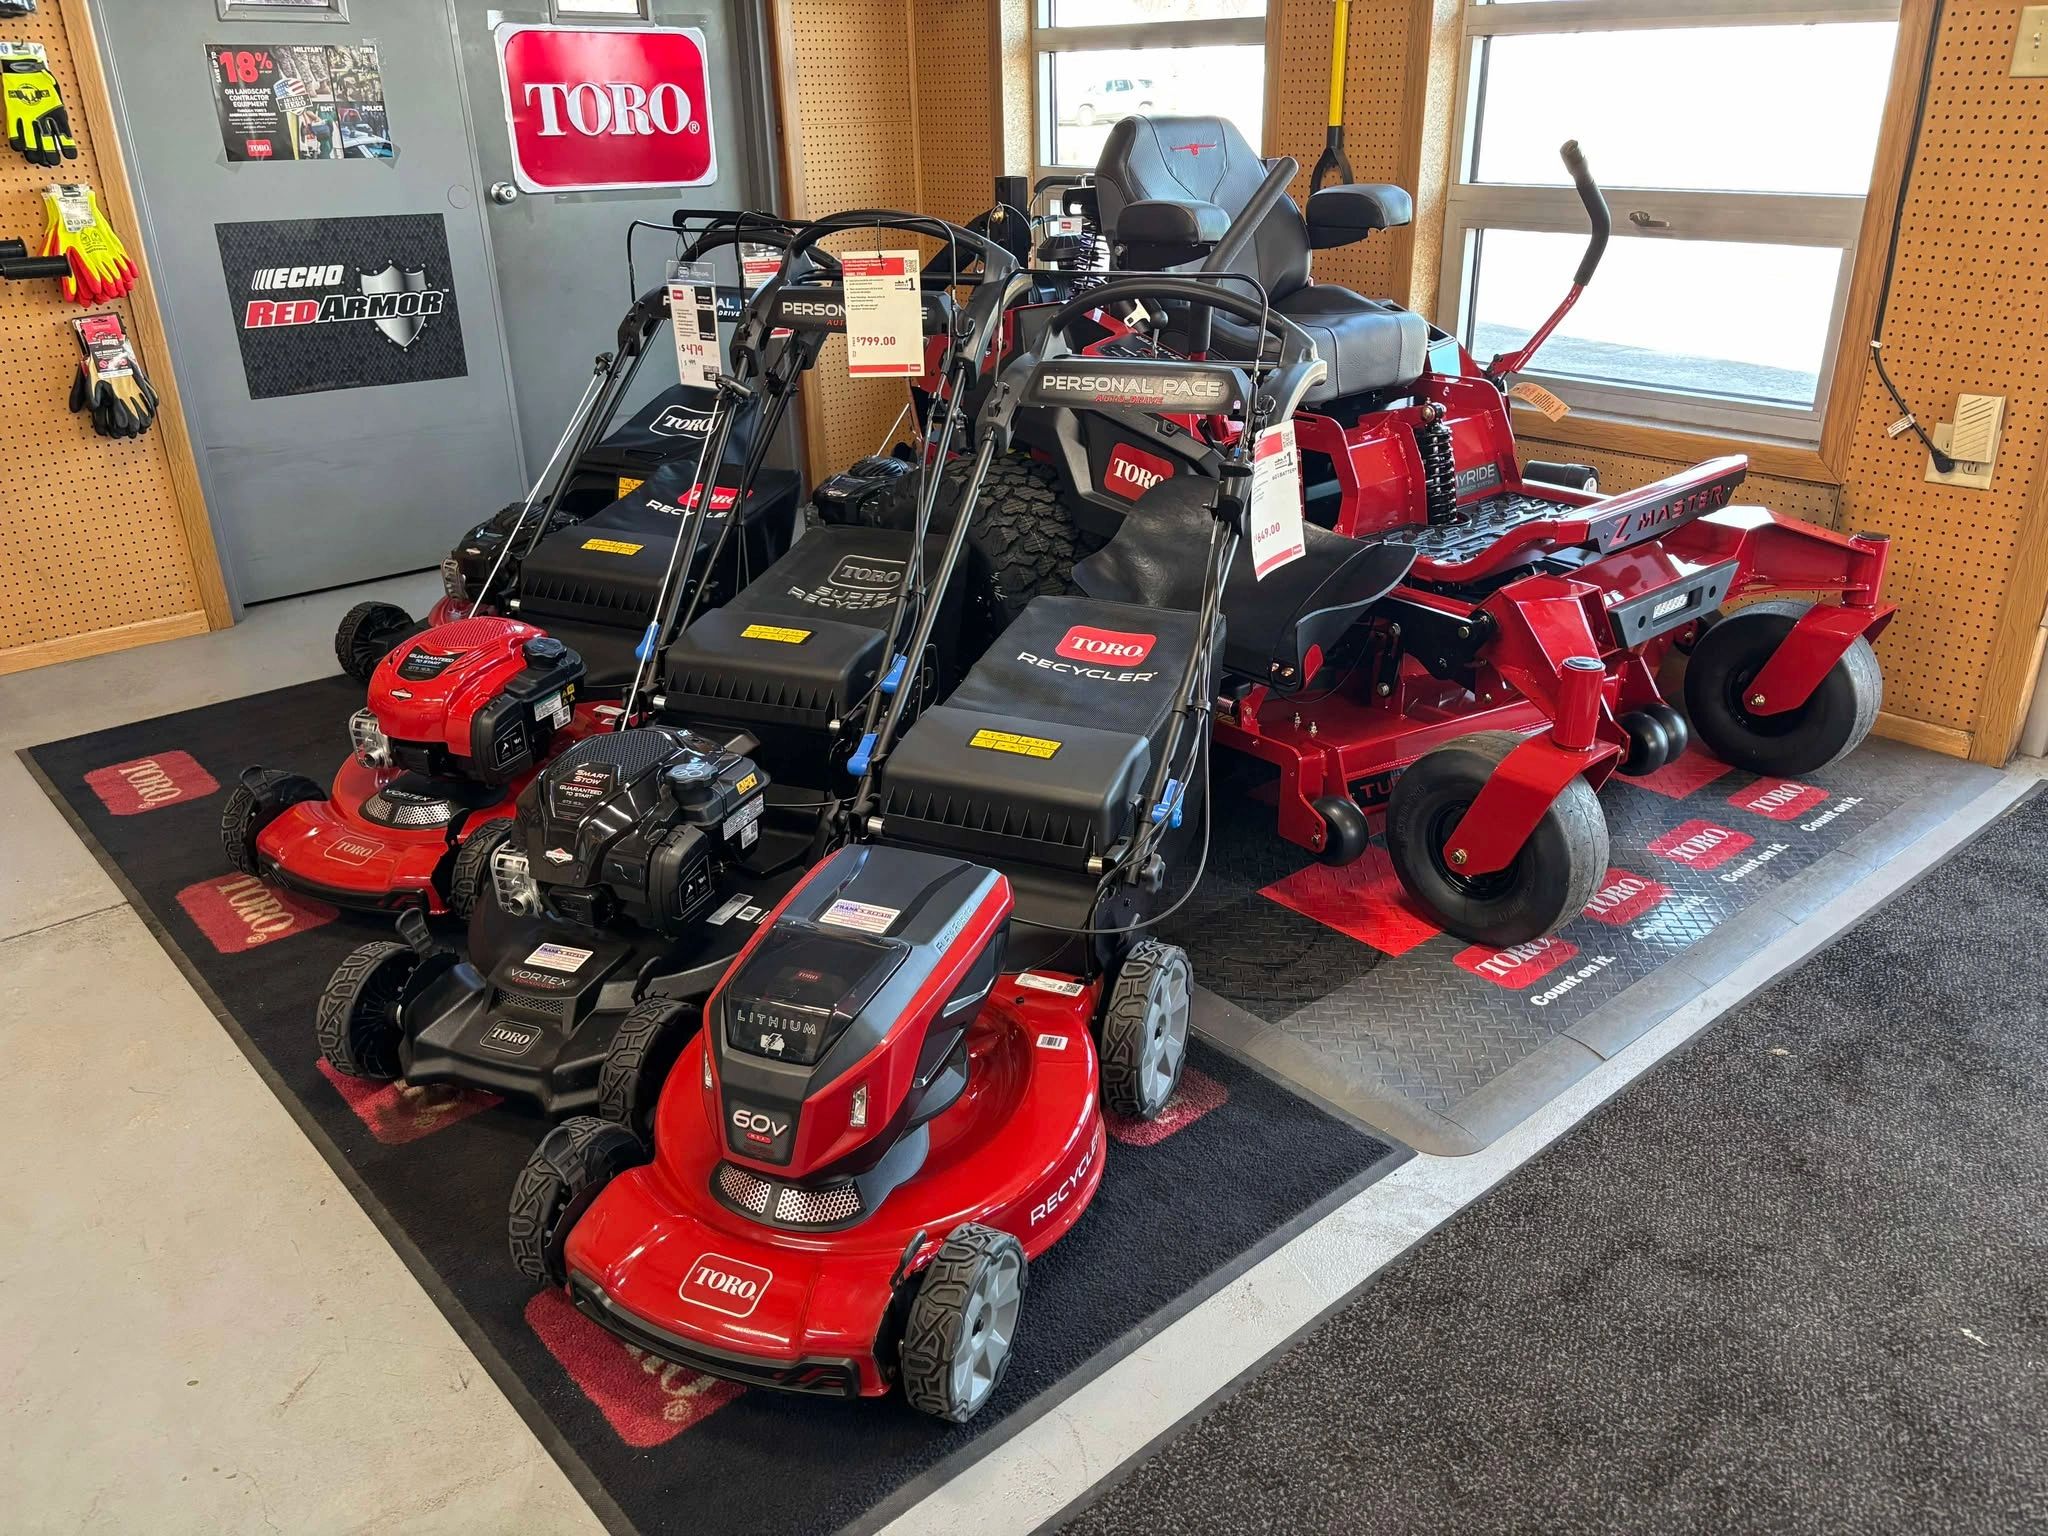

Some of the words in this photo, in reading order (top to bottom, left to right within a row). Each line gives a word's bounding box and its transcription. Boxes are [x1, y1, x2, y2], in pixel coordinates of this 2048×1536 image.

[219, 51, 272, 83] 18%
[284, 100, 306, 109] HERO
[272, 264, 345, 290] ECHO
[782, 302, 847, 317] PERSON
[856, 336, 896, 347] $799.00
[1042, 375, 1154, 394] PERSONAL
[1162, 379, 1224, 397] PACE
[662, 415, 714, 432] TORO
[646, 499, 729, 518] RECYLE
[1608, 514, 1632, 547] Z
[1637, 485, 1724, 531] MASTER
[840, 565, 901, 583] TORO
[815, 585, 890, 602] SUPER
[409, 653, 454, 663] GUARANTEED
[1071, 636, 1144, 658] TORO
[1017, 651, 1155, 682] RECYCLER
[118, 759, 182, 803] TORO
[573, 775, 601, 785] STOW
[575, 769, 610, 779] SMART
[385, 788, 431, 801] VORTEX
[559, 784, 603, 795] GUARANTEED
[1747, 783, 1806, 812] TORO
[1800, 810, 1839, 832] Count
[1835, 801, 1851, 813] on
[336, 840, 373, 857] TORO
[1667, 828, 1729, 861] TORO
[1720, 857, 1761, 882] Count
[1758, 849, 1774, 863] on
[217, 875, 294, 935] TORO
[511, 968, 570, 987] VORTEX
[1530, 975, 1583, 1006] Count
[1580, 964, 1600, 978] on
[737, 1009, 816, 1035] LITHIUM
[491, 1027, 530, 1045] TORO
[733, 1109, 788, 1137] 60V
[1031, 1122, 1100, 1227] RECYCLER
[693, 1266, 754, 1299] TORO
